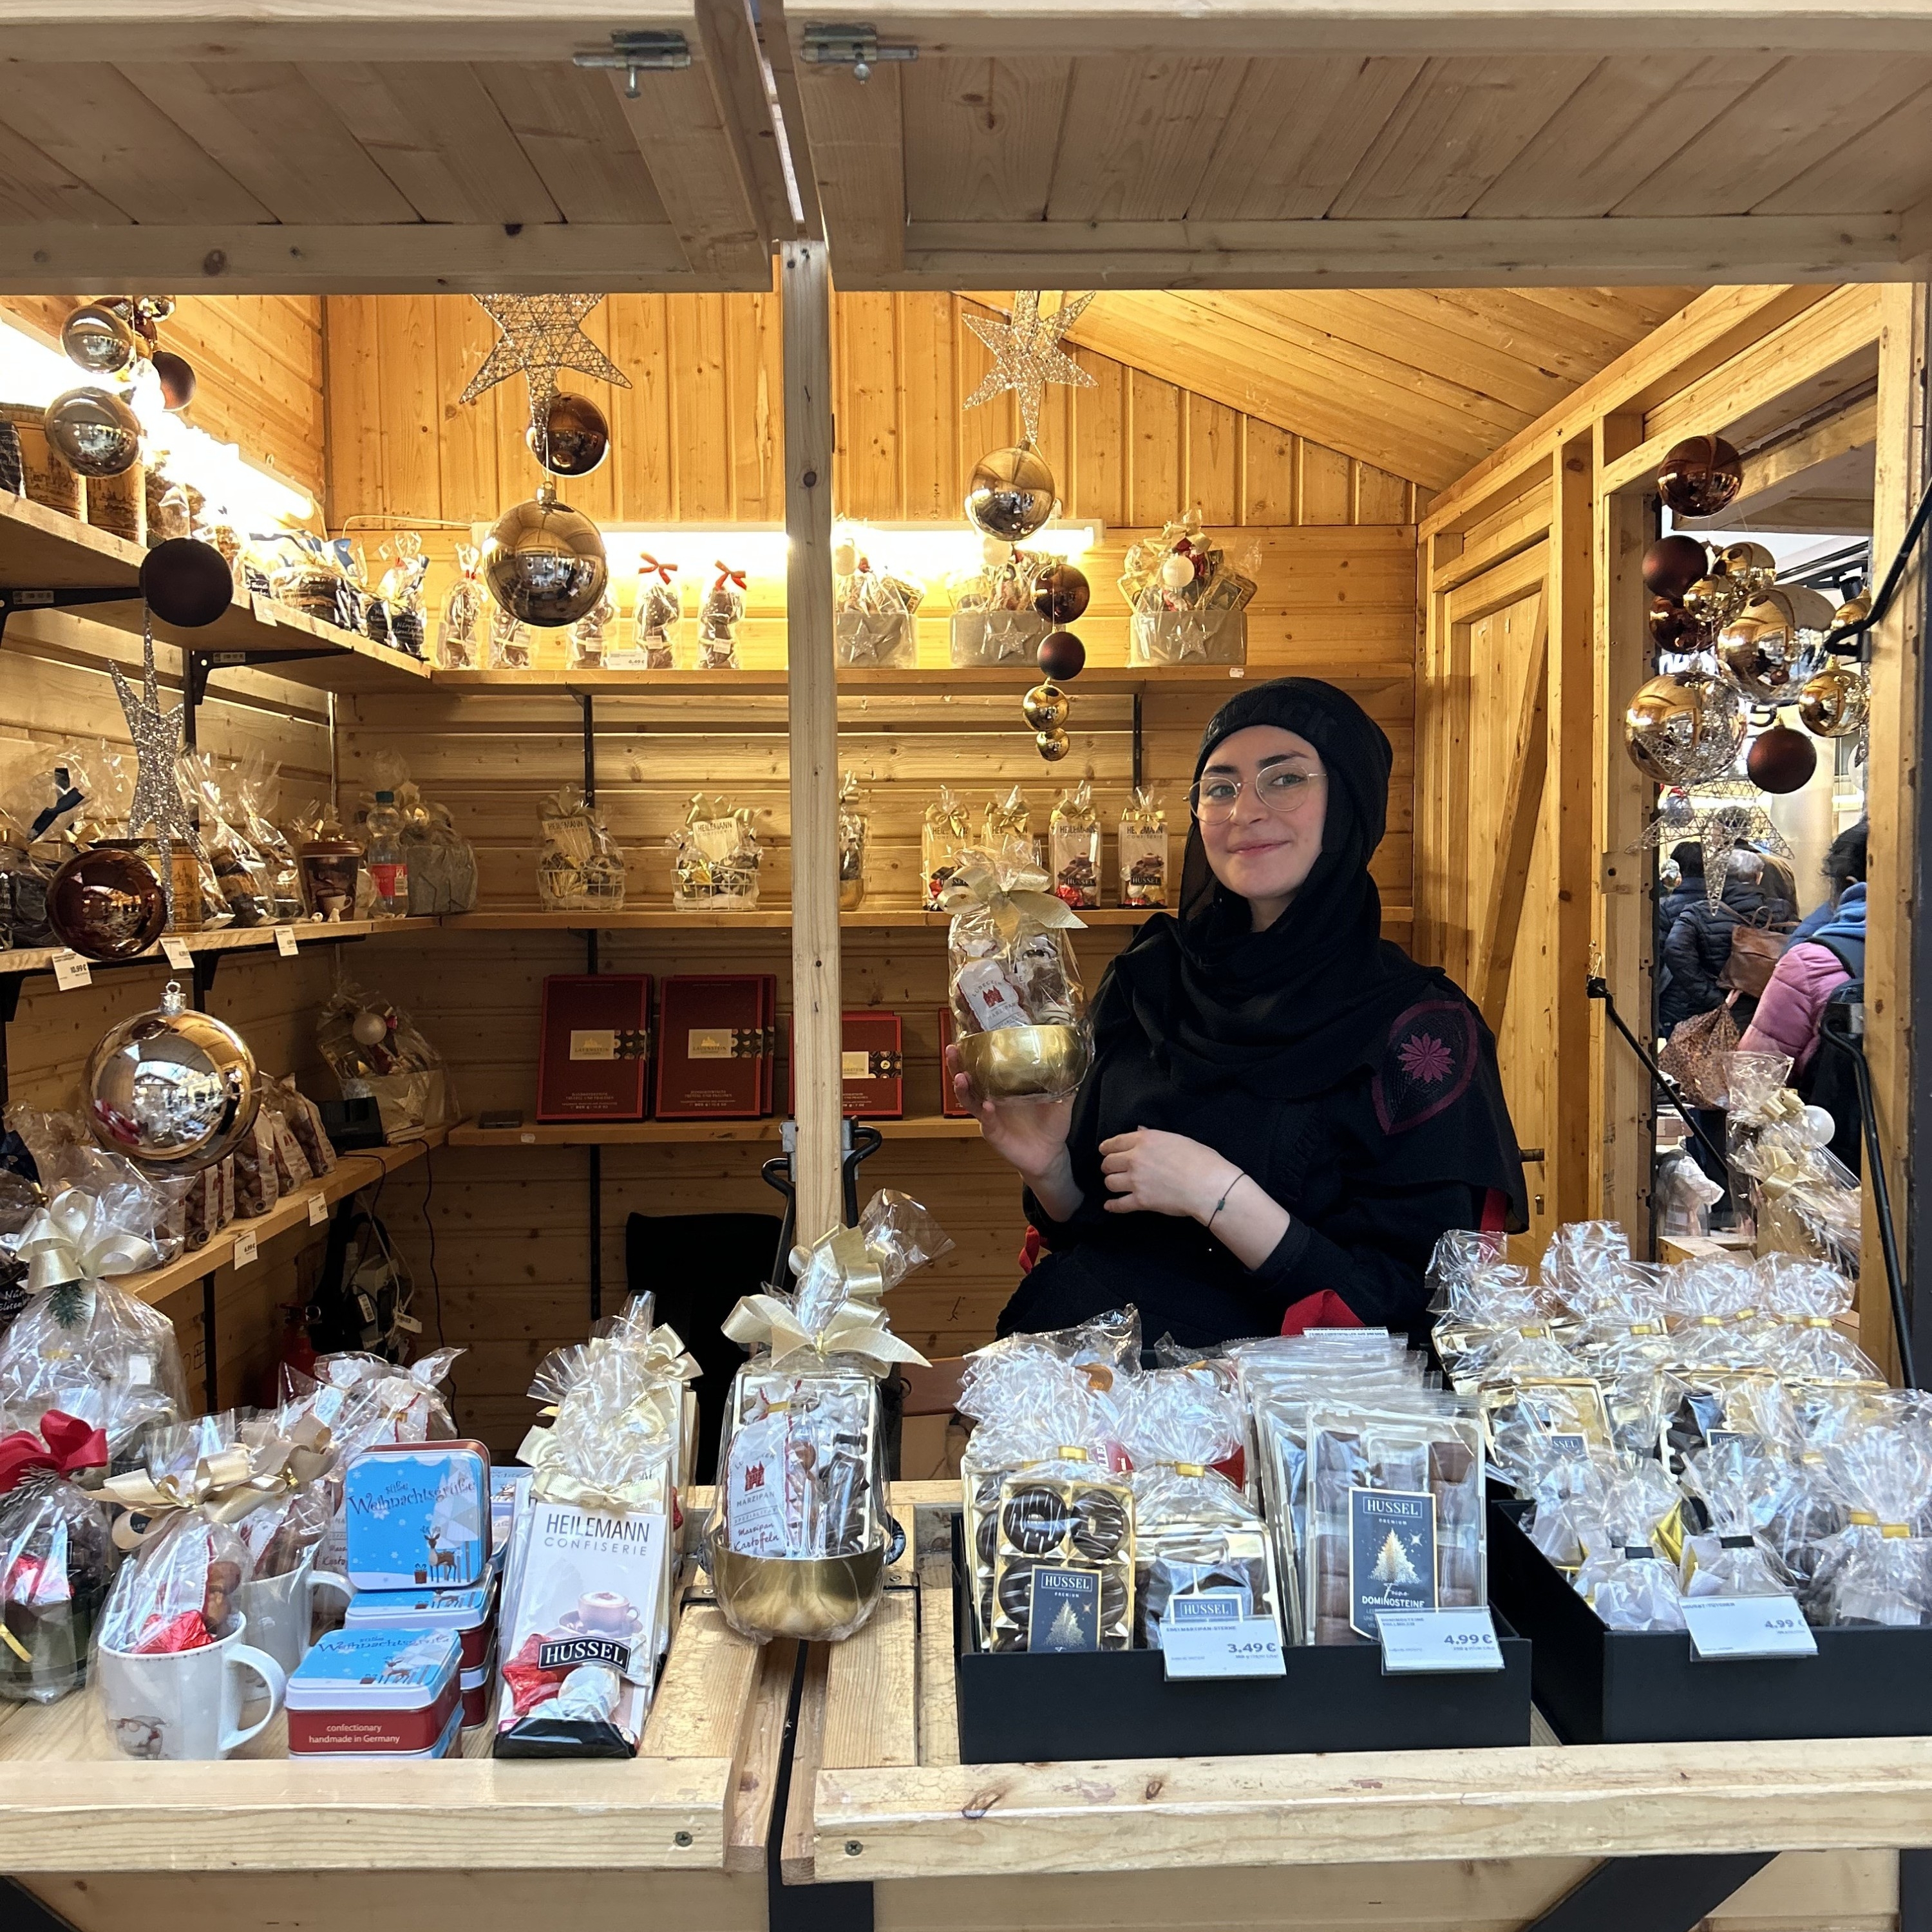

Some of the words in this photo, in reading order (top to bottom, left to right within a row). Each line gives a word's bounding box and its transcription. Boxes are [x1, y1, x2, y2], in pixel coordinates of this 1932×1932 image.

[1133, 876, 1159, 884] HUSSEL
[385, 1481, 408, 1495] süße
[348, 1477, 476, 1515] Weihnachtsgrüße
[737, 1492, 775, 1507] MARZIPAN
[1367, 1499, 1419, 1515] HUSSEL
[546, 1513, 650, 1543] HEILEMANN
[737, 1522, 773, 1537] Marzipan
[544, 1537, 647, 1556] CONFISERIE
[734, 1531, 779, 1552] Kartoffeln
[1045, 1575, 1090, 1589] HUSSEL
[1362, 1595, 1425, 1608] DOMINOSTEINE
[1184, 1604, 1229, 1615] HUSSEL
[1765, 1619, 1794, 1628] 4.99
[1444, 1634, 1479, 1645] 4.99
[1482, 1634, 1492, 1643] €
[545, 1642, 623, 1664] HUSSEL
[1227, 1643, 1263, 1653] 3.49
[1267, 1642, 1276, 1652] €
[327, 1724, 382, 1732] confectionary
[363, 1735, 400, 1743] Germany
